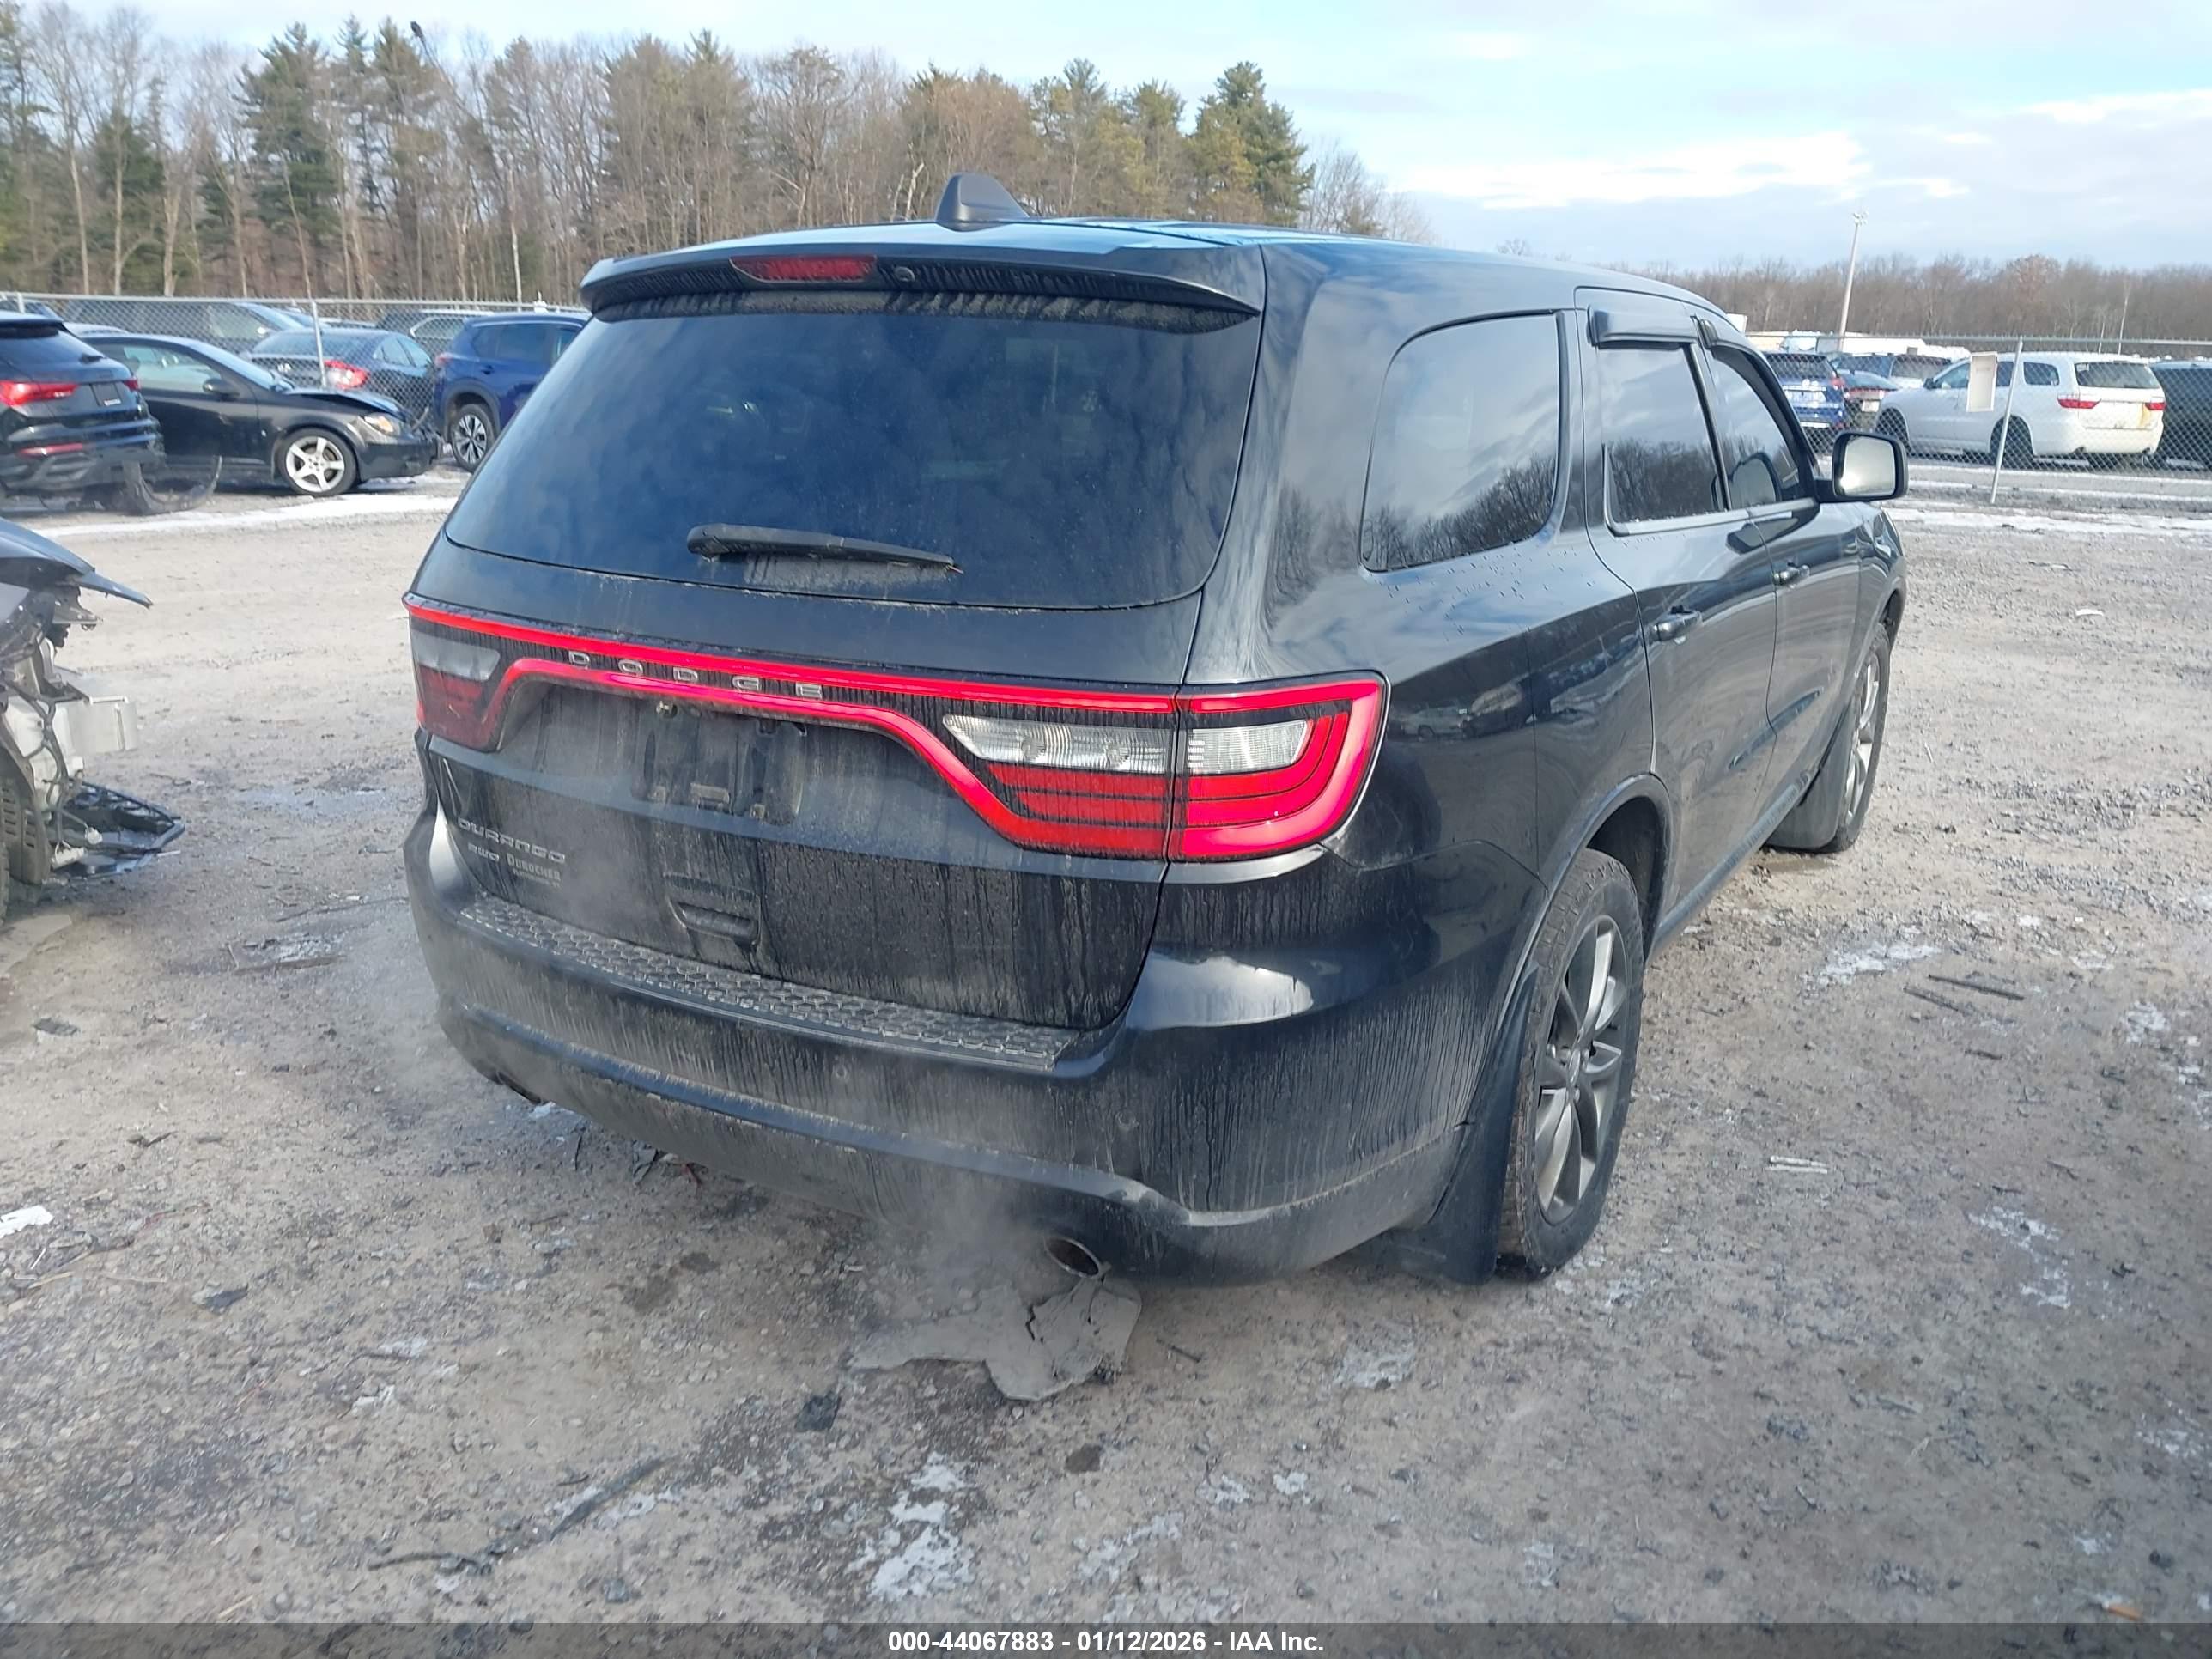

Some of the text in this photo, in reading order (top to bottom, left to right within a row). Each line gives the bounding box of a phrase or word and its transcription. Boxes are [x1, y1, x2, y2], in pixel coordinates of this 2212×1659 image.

[568, 650, 823, 700] DODGE
[457, 817, 566, 864] DURANGO
[467, 842, 500, 862] AWD
